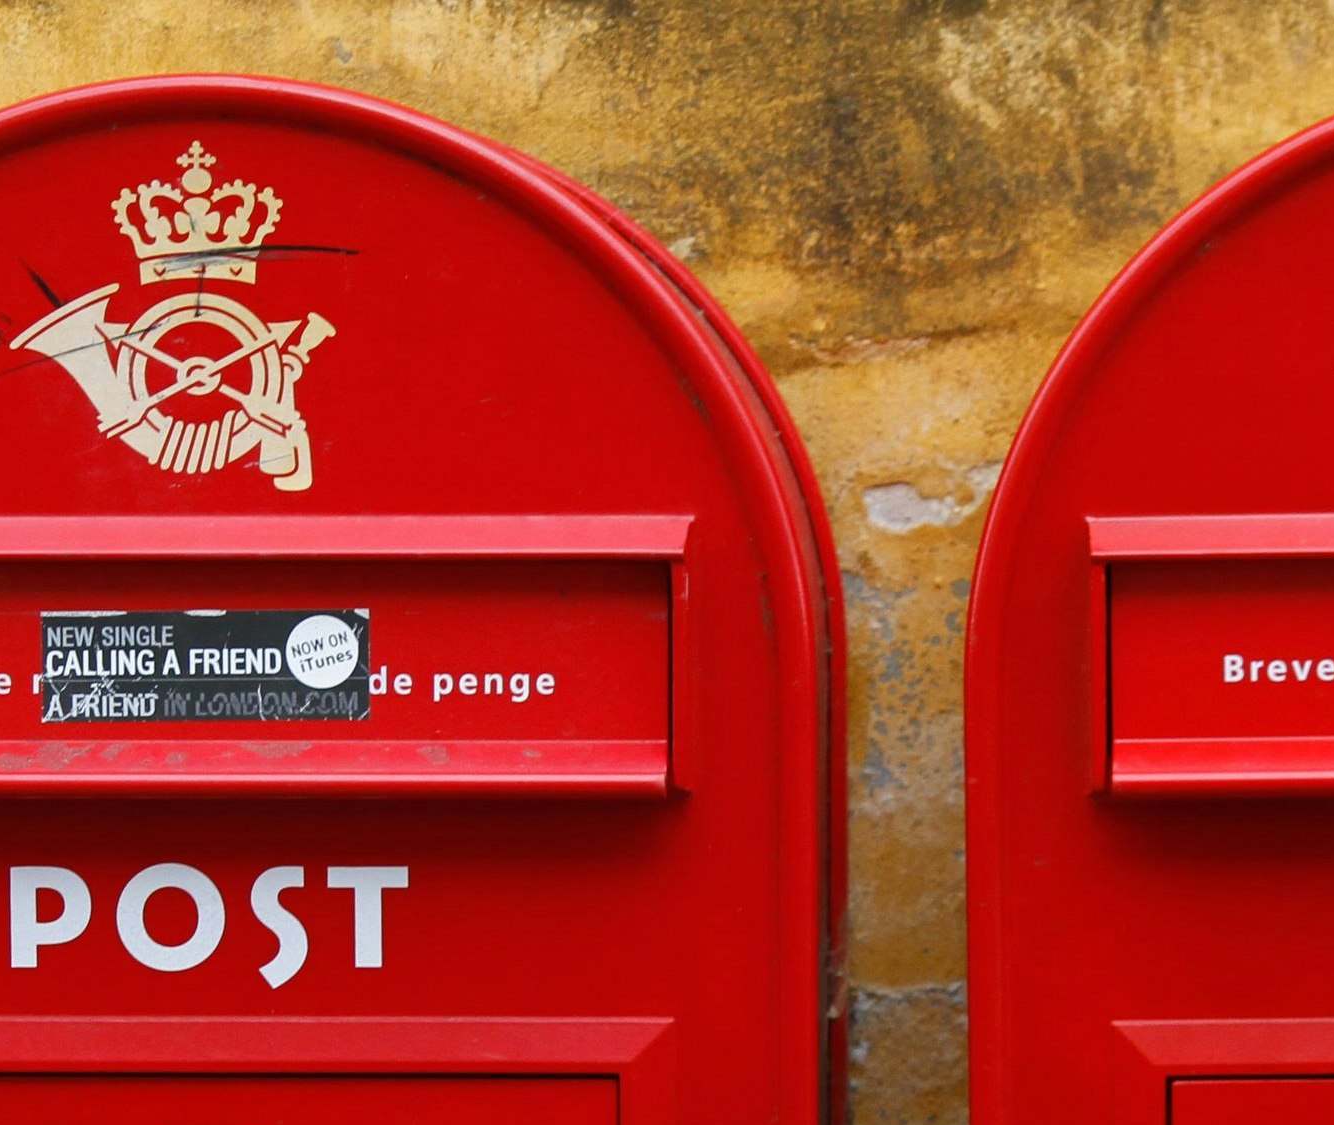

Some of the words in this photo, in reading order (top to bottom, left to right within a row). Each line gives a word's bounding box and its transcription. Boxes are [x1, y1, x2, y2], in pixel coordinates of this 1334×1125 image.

[47, 627, 94, 647] NEW
[102, 626, 173, 646] SINGLE
[291, 641, 326, 658] NOW
[328, 632, 348, 646] ON
[46, 649, 155, 675] CALLING
[163, 650, 180, 674] A
[189, 648, 282, 674] FRIEND
[299, 651, 353, 672] iTunes
[432, 672, 556, 702] penge
[48, 694, 63, 717] A
[72, 694, 155, 716] FRIEND
[10, 863, 409, 989] POST
